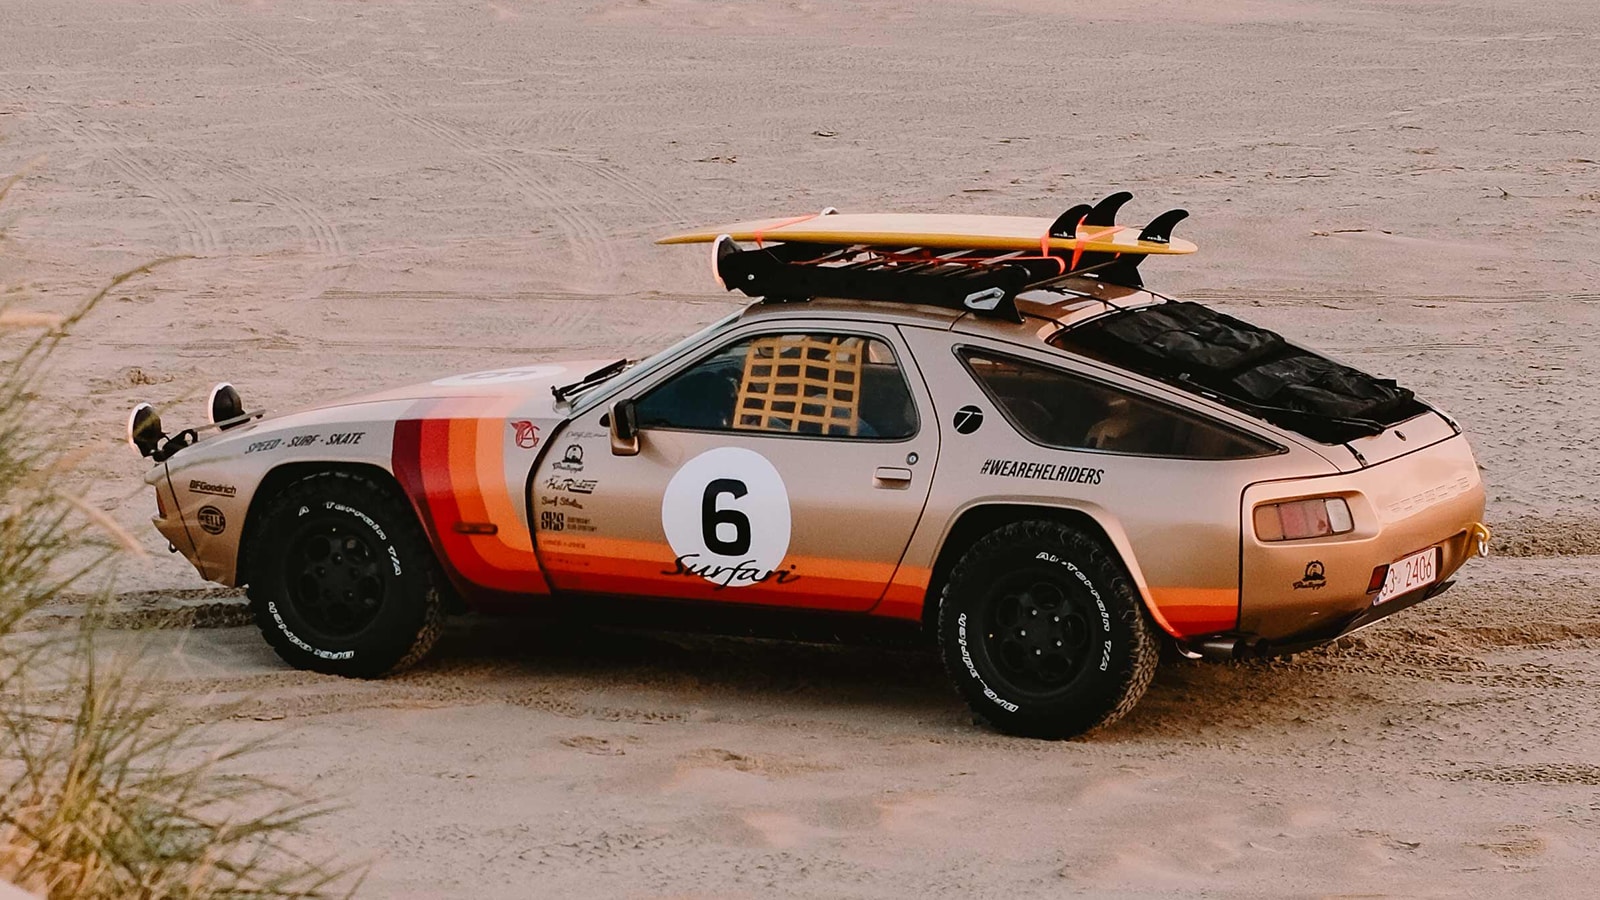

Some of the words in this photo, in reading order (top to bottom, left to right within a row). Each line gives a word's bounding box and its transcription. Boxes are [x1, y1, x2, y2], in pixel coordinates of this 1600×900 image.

[244, 438, 281, 454] SPEED
[287, 434, 320, 448] SURF
[326, 432, 366, 446] SKATE
[189, 479, 237, 495] BFGoodrich
[980, 458, 1105, 485] #WEAREHELRIDERS
[701, 478, 752, 556] 6
[660, 553, 802, 591] Surfari
[1405, 552, 1433, 588] 2406
